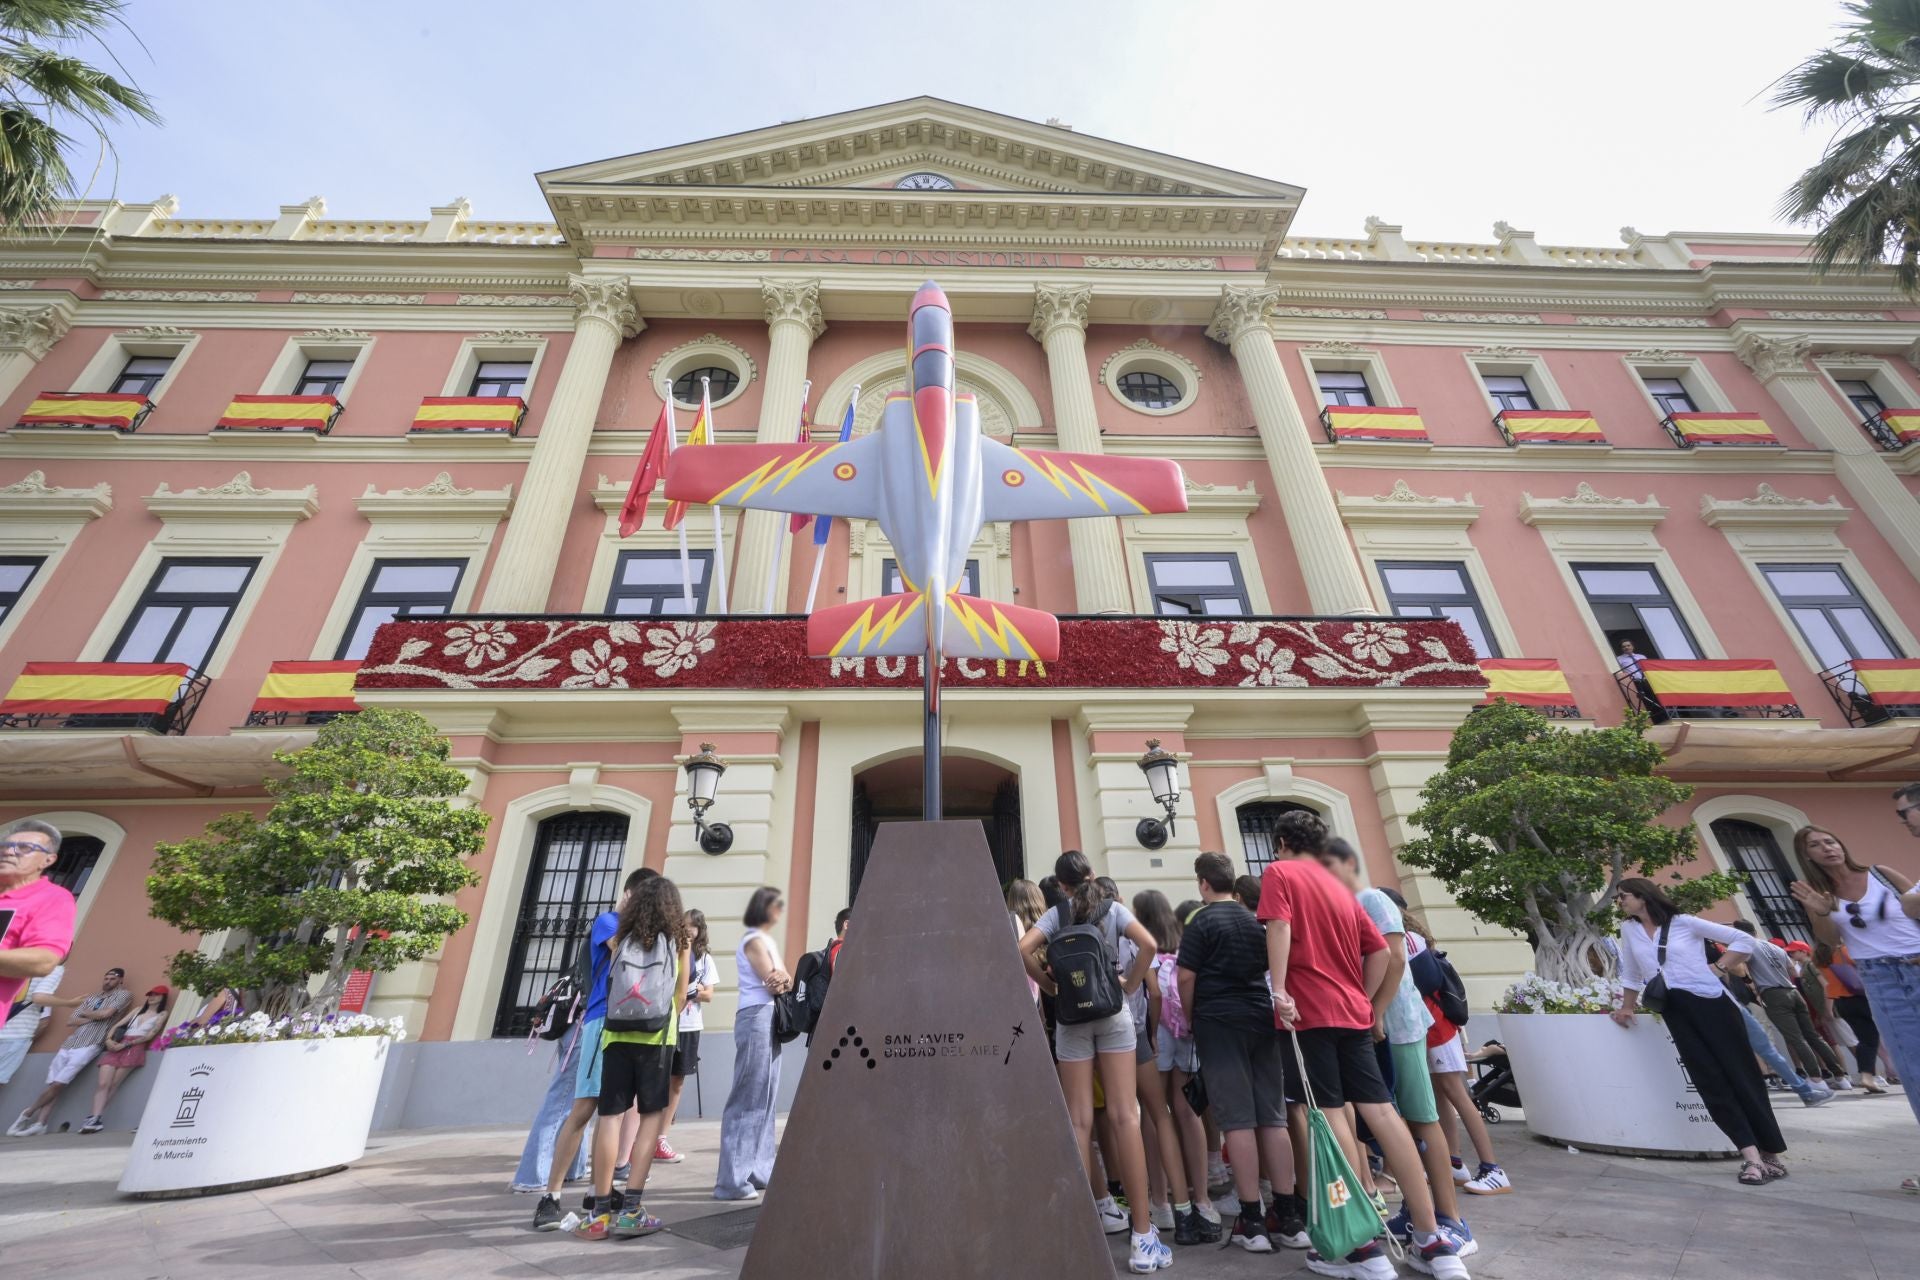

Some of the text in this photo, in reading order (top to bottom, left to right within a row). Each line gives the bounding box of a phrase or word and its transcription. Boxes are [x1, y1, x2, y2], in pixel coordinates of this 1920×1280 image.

[884, 1034, 912, 1045] SAN
[884, 1044, 1000, 1058] CIUDAD DEL AIRE
[1675, 1102, 1706, 1110] Ayunta
[1688, 1114, 1700, 1123] de
[152, 1136, 208, 1149] Ayuntamiento
[153, 1150, 193, 1161] de Murcia
